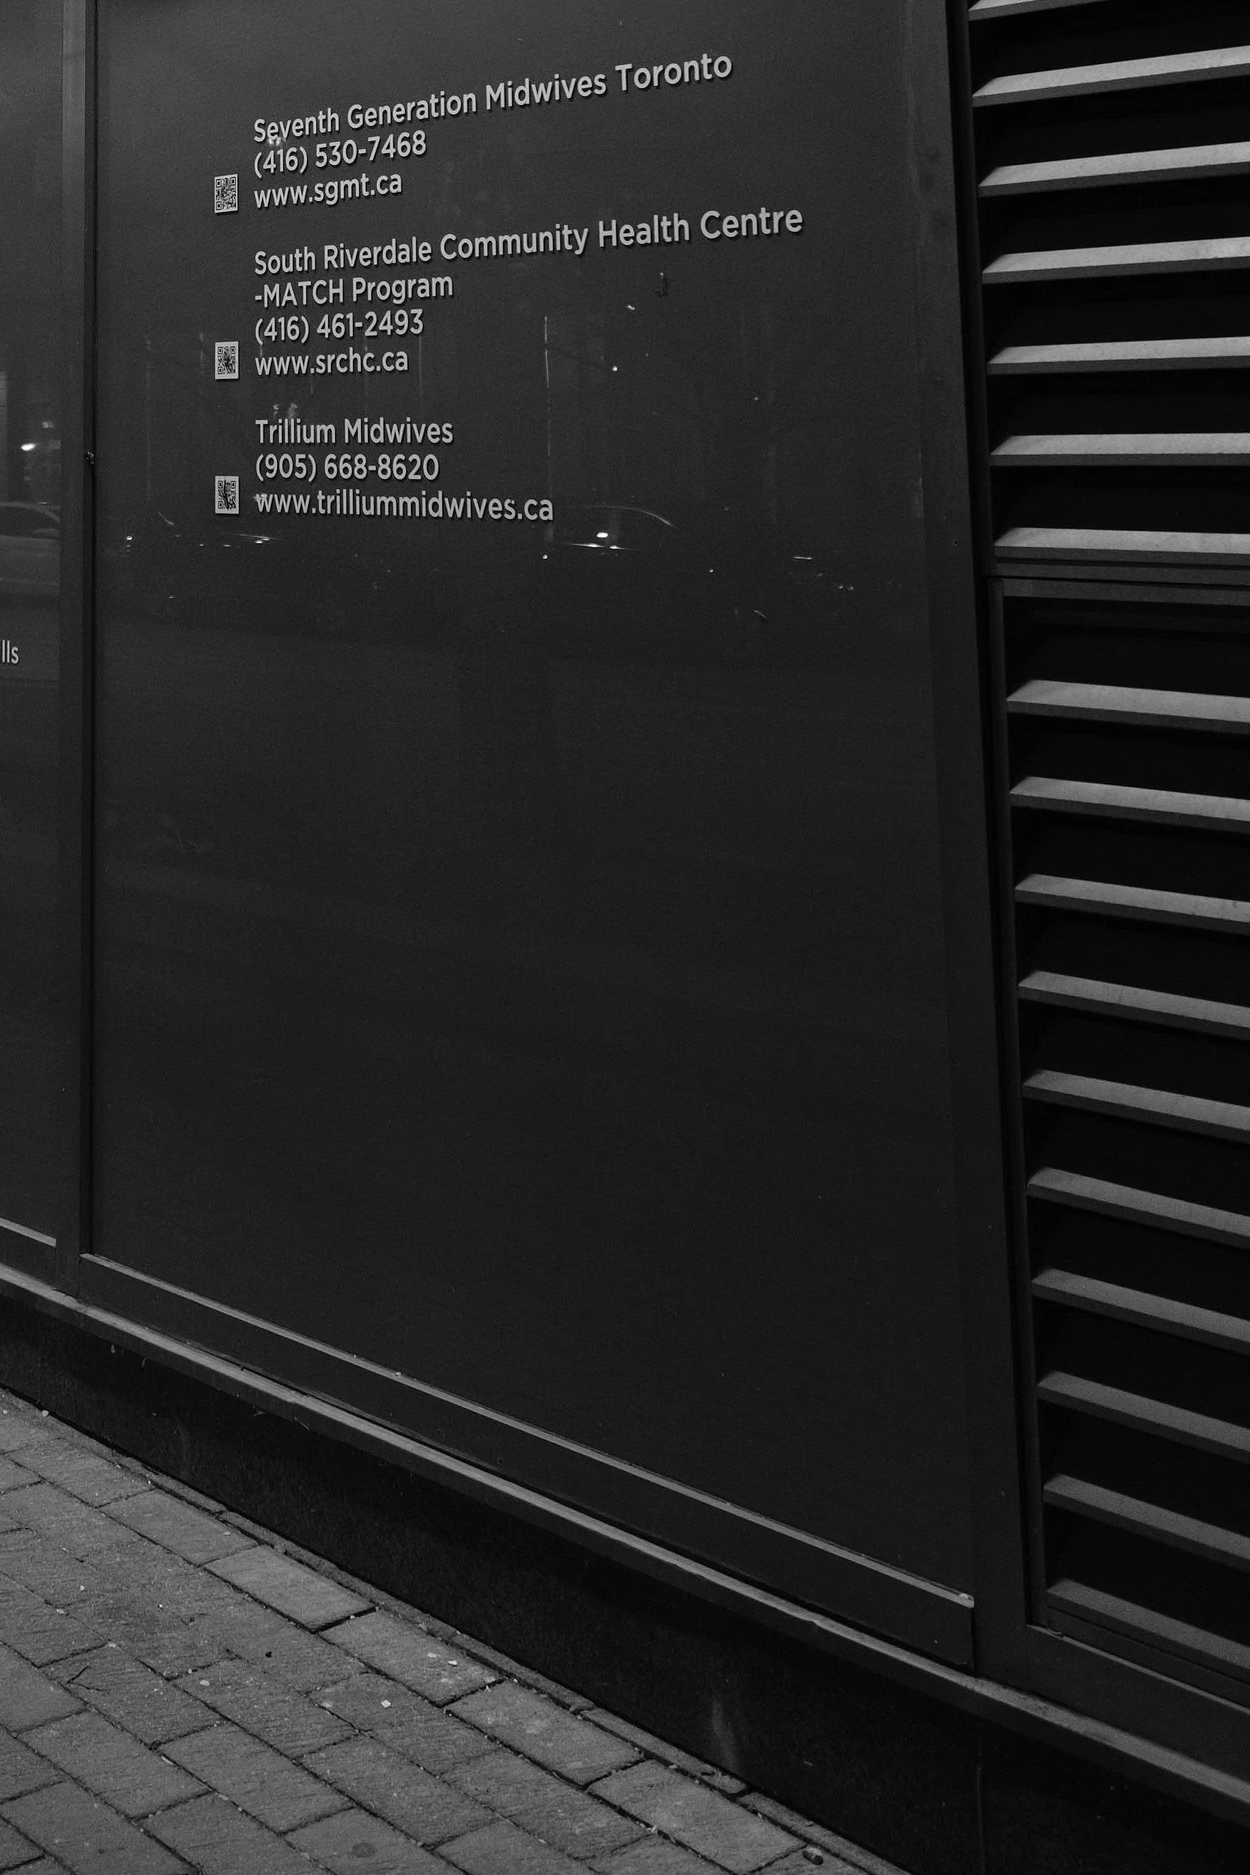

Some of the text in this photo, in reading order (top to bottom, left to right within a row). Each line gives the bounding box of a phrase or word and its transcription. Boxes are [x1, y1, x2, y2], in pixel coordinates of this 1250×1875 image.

[253, 53, 732, 143] Seventh Generation Midwives Toronto
[254, 130, 426, 179] (416) 530-7468
[253, 172, 402, 208] www.sgmt.ca
[254, 208, 803, 275] South Riverdale Community Health Centre
[254, 276, 453, 308] -MATCH Program
[255, 308, 424, 346] (416) 461-2493
[254, 346, 408, 376] www.srchc.ca
[255, 416, 453, 444] Trillium Midwives
[255, 453, 439, 483] (905) 668-8620
[253, 488, 553, 521] www.trilliummidwives.ca
